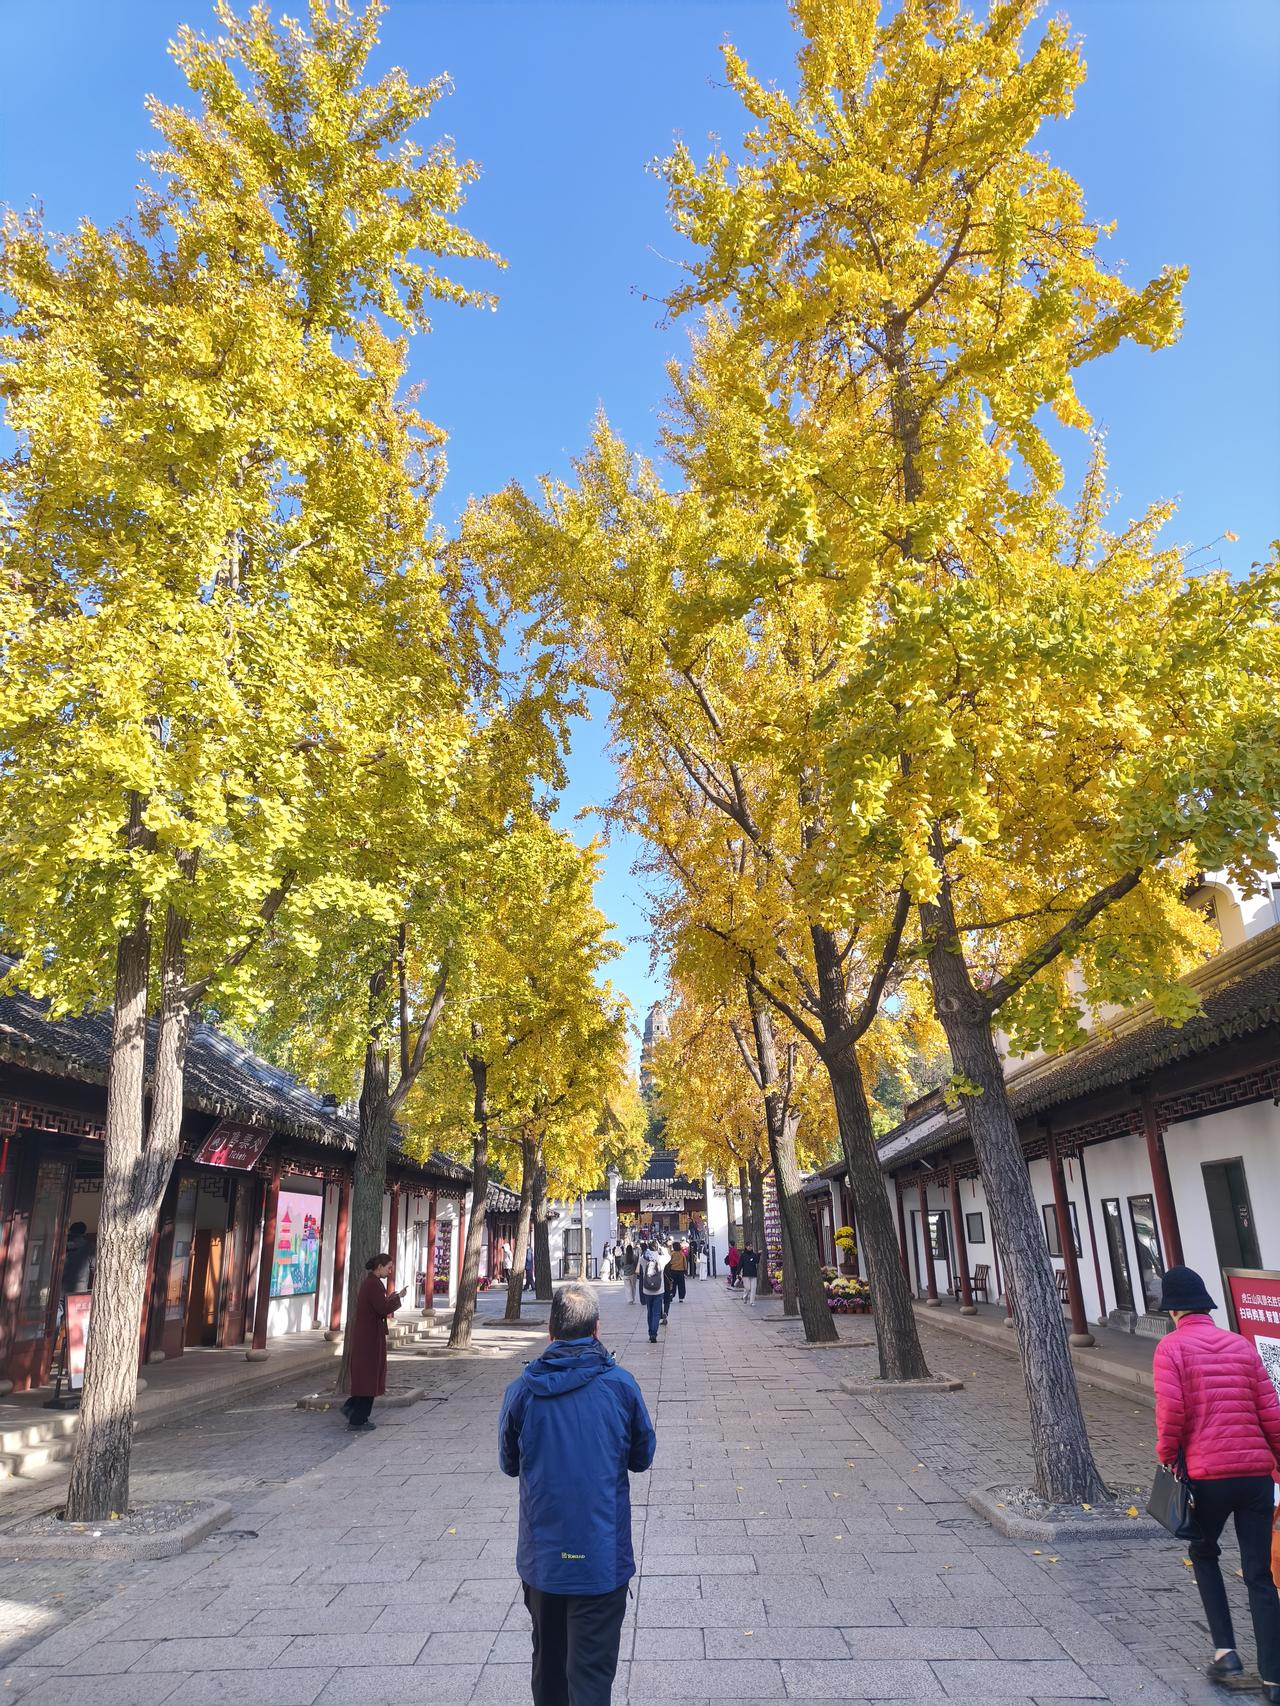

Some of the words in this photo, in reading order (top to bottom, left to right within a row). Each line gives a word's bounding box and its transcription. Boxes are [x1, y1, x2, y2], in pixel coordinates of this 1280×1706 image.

[1239, 1307, 1266, 1322] 扫码购票
[1265, 1310, 1280, 1324] 智慧
